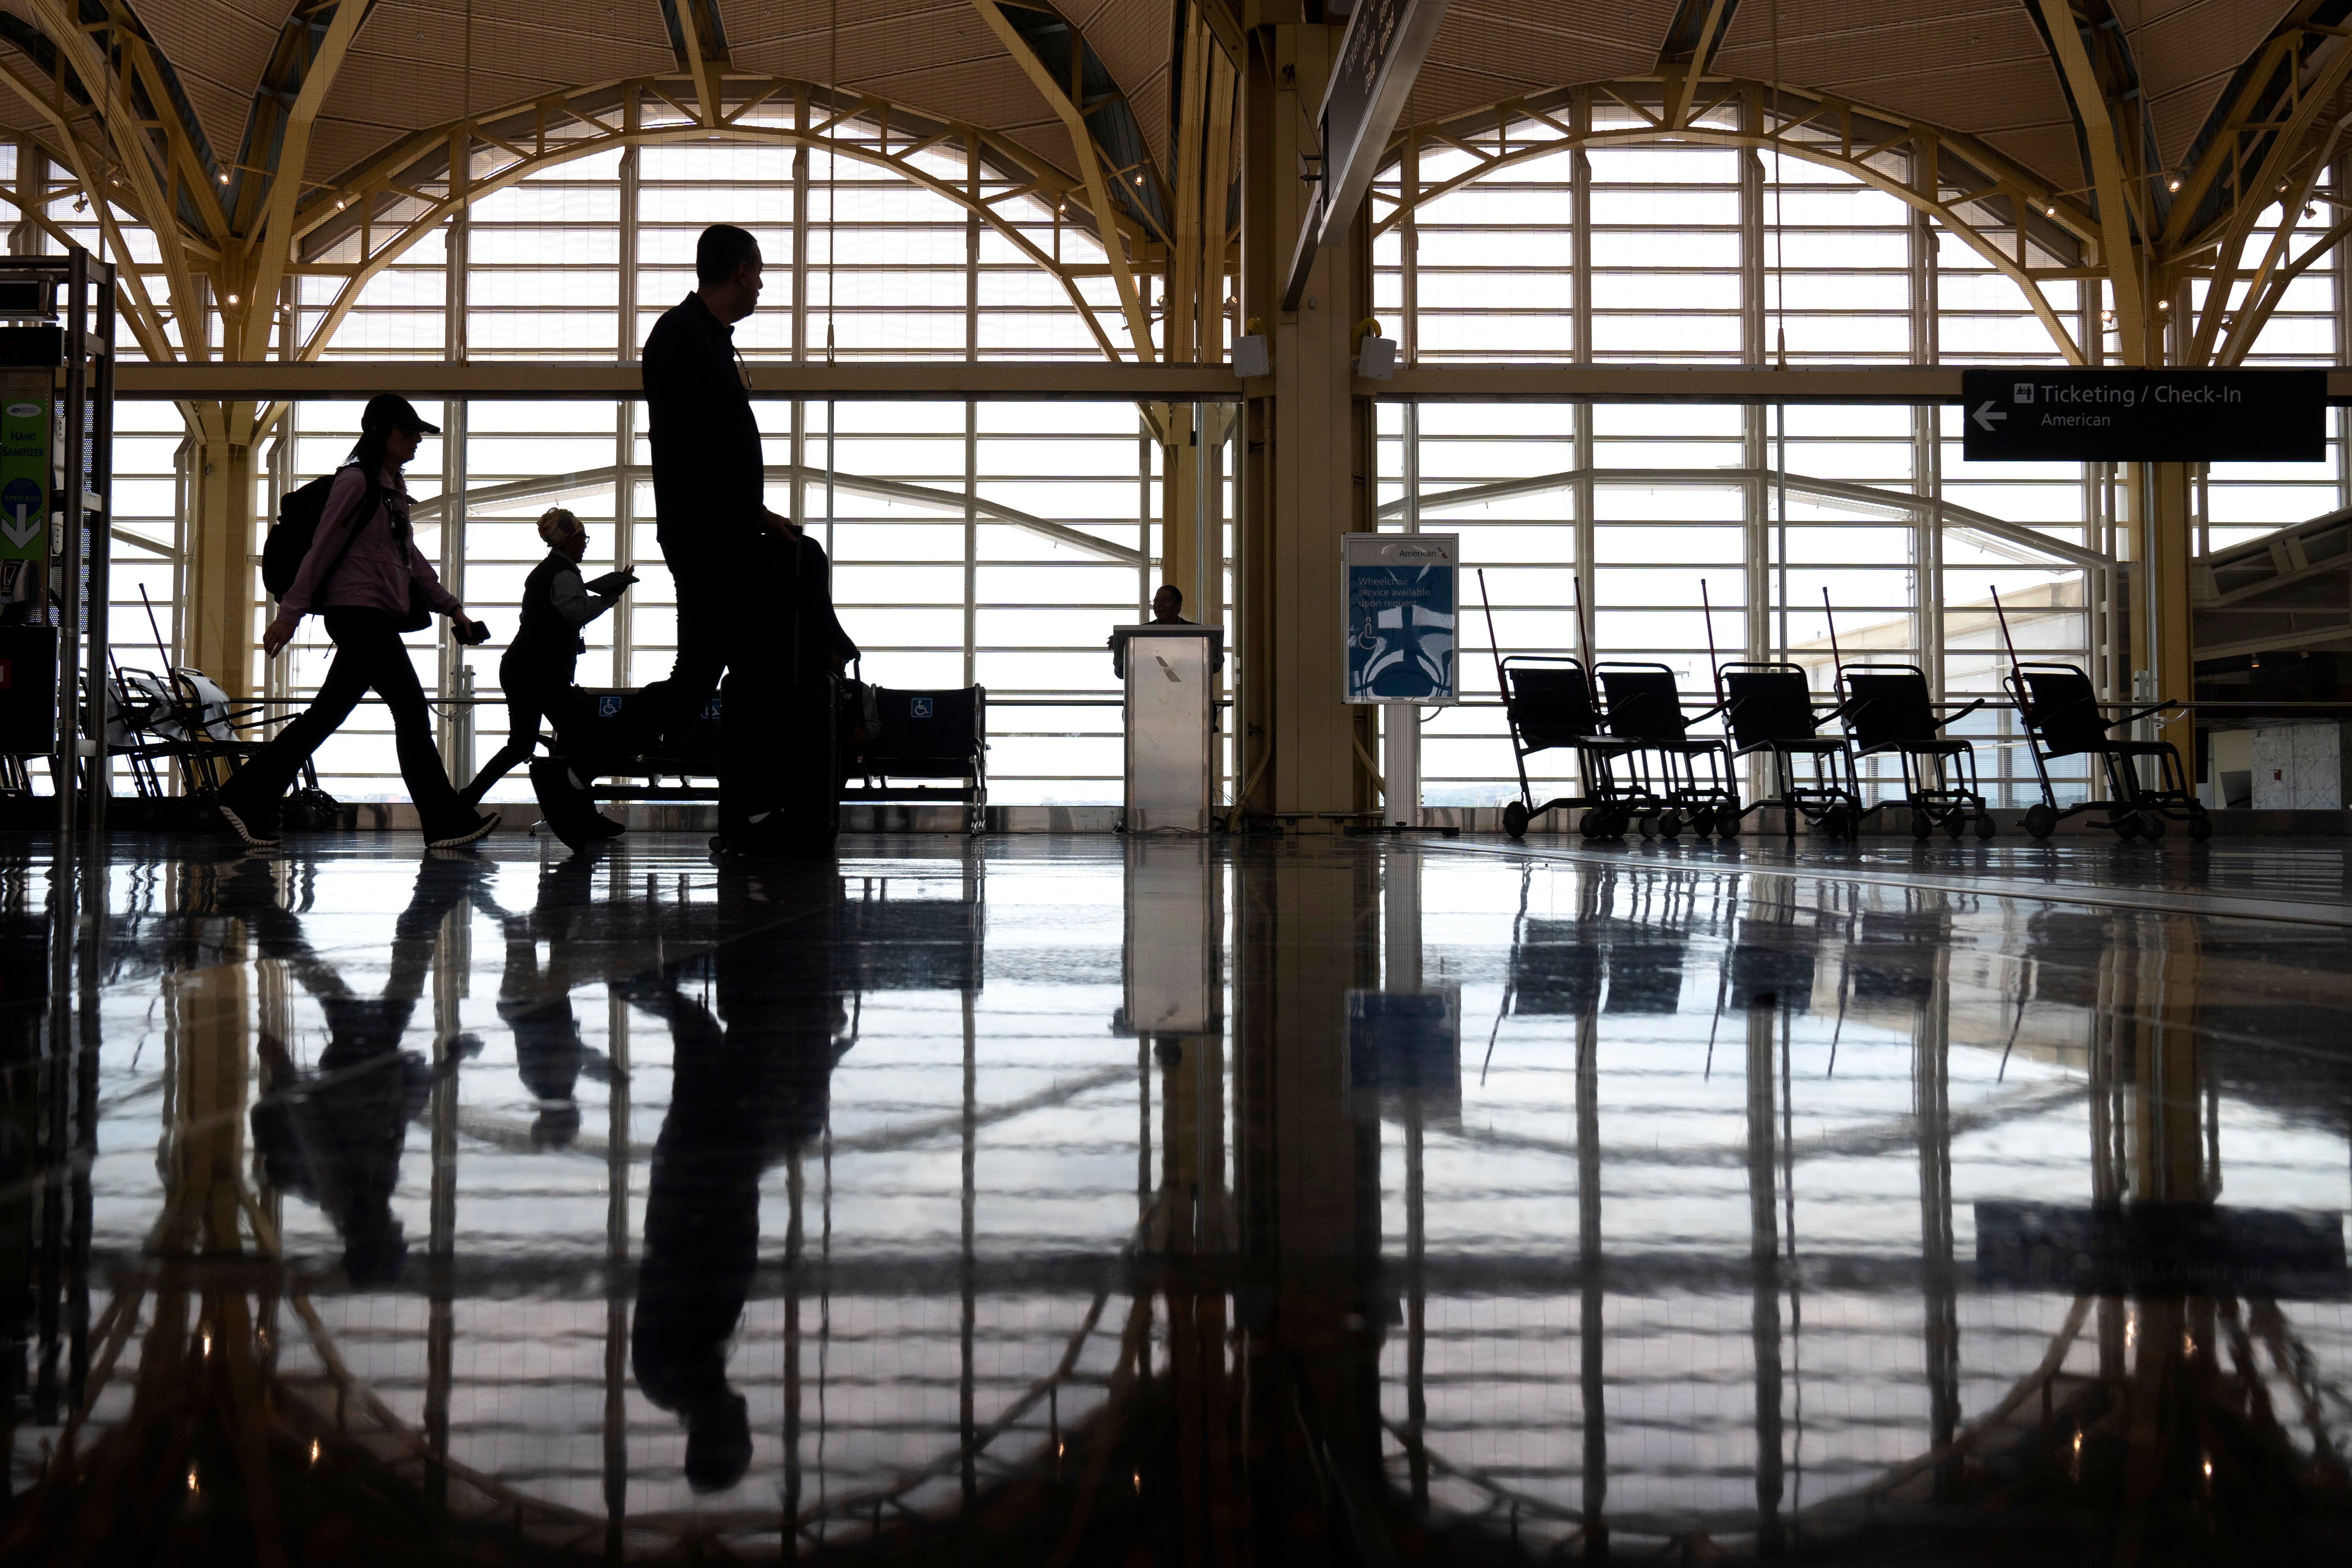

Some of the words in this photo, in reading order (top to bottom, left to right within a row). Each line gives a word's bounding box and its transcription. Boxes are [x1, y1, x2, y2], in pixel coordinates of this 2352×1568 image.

[1345, 13, 1366, 82] Ticketing
[1363, 30, 1376, 72] Alaska
[1365, 60, 1376, 94] Delta
[1380, 4, 1394, 55] United
[2041, 385, 2135, 407] Ticketing
[2141, 385, 2149, 403] /
[2154, 385, 2242, 403] Check-In
[2041, 413, 2111, 427] American
[1358, 577, 1409, 585] Wheelchair
[1358, 588, 1389, 596] service
[1391, 588, 1430, 596] available
[1359, 600, 1381, 608] upon
